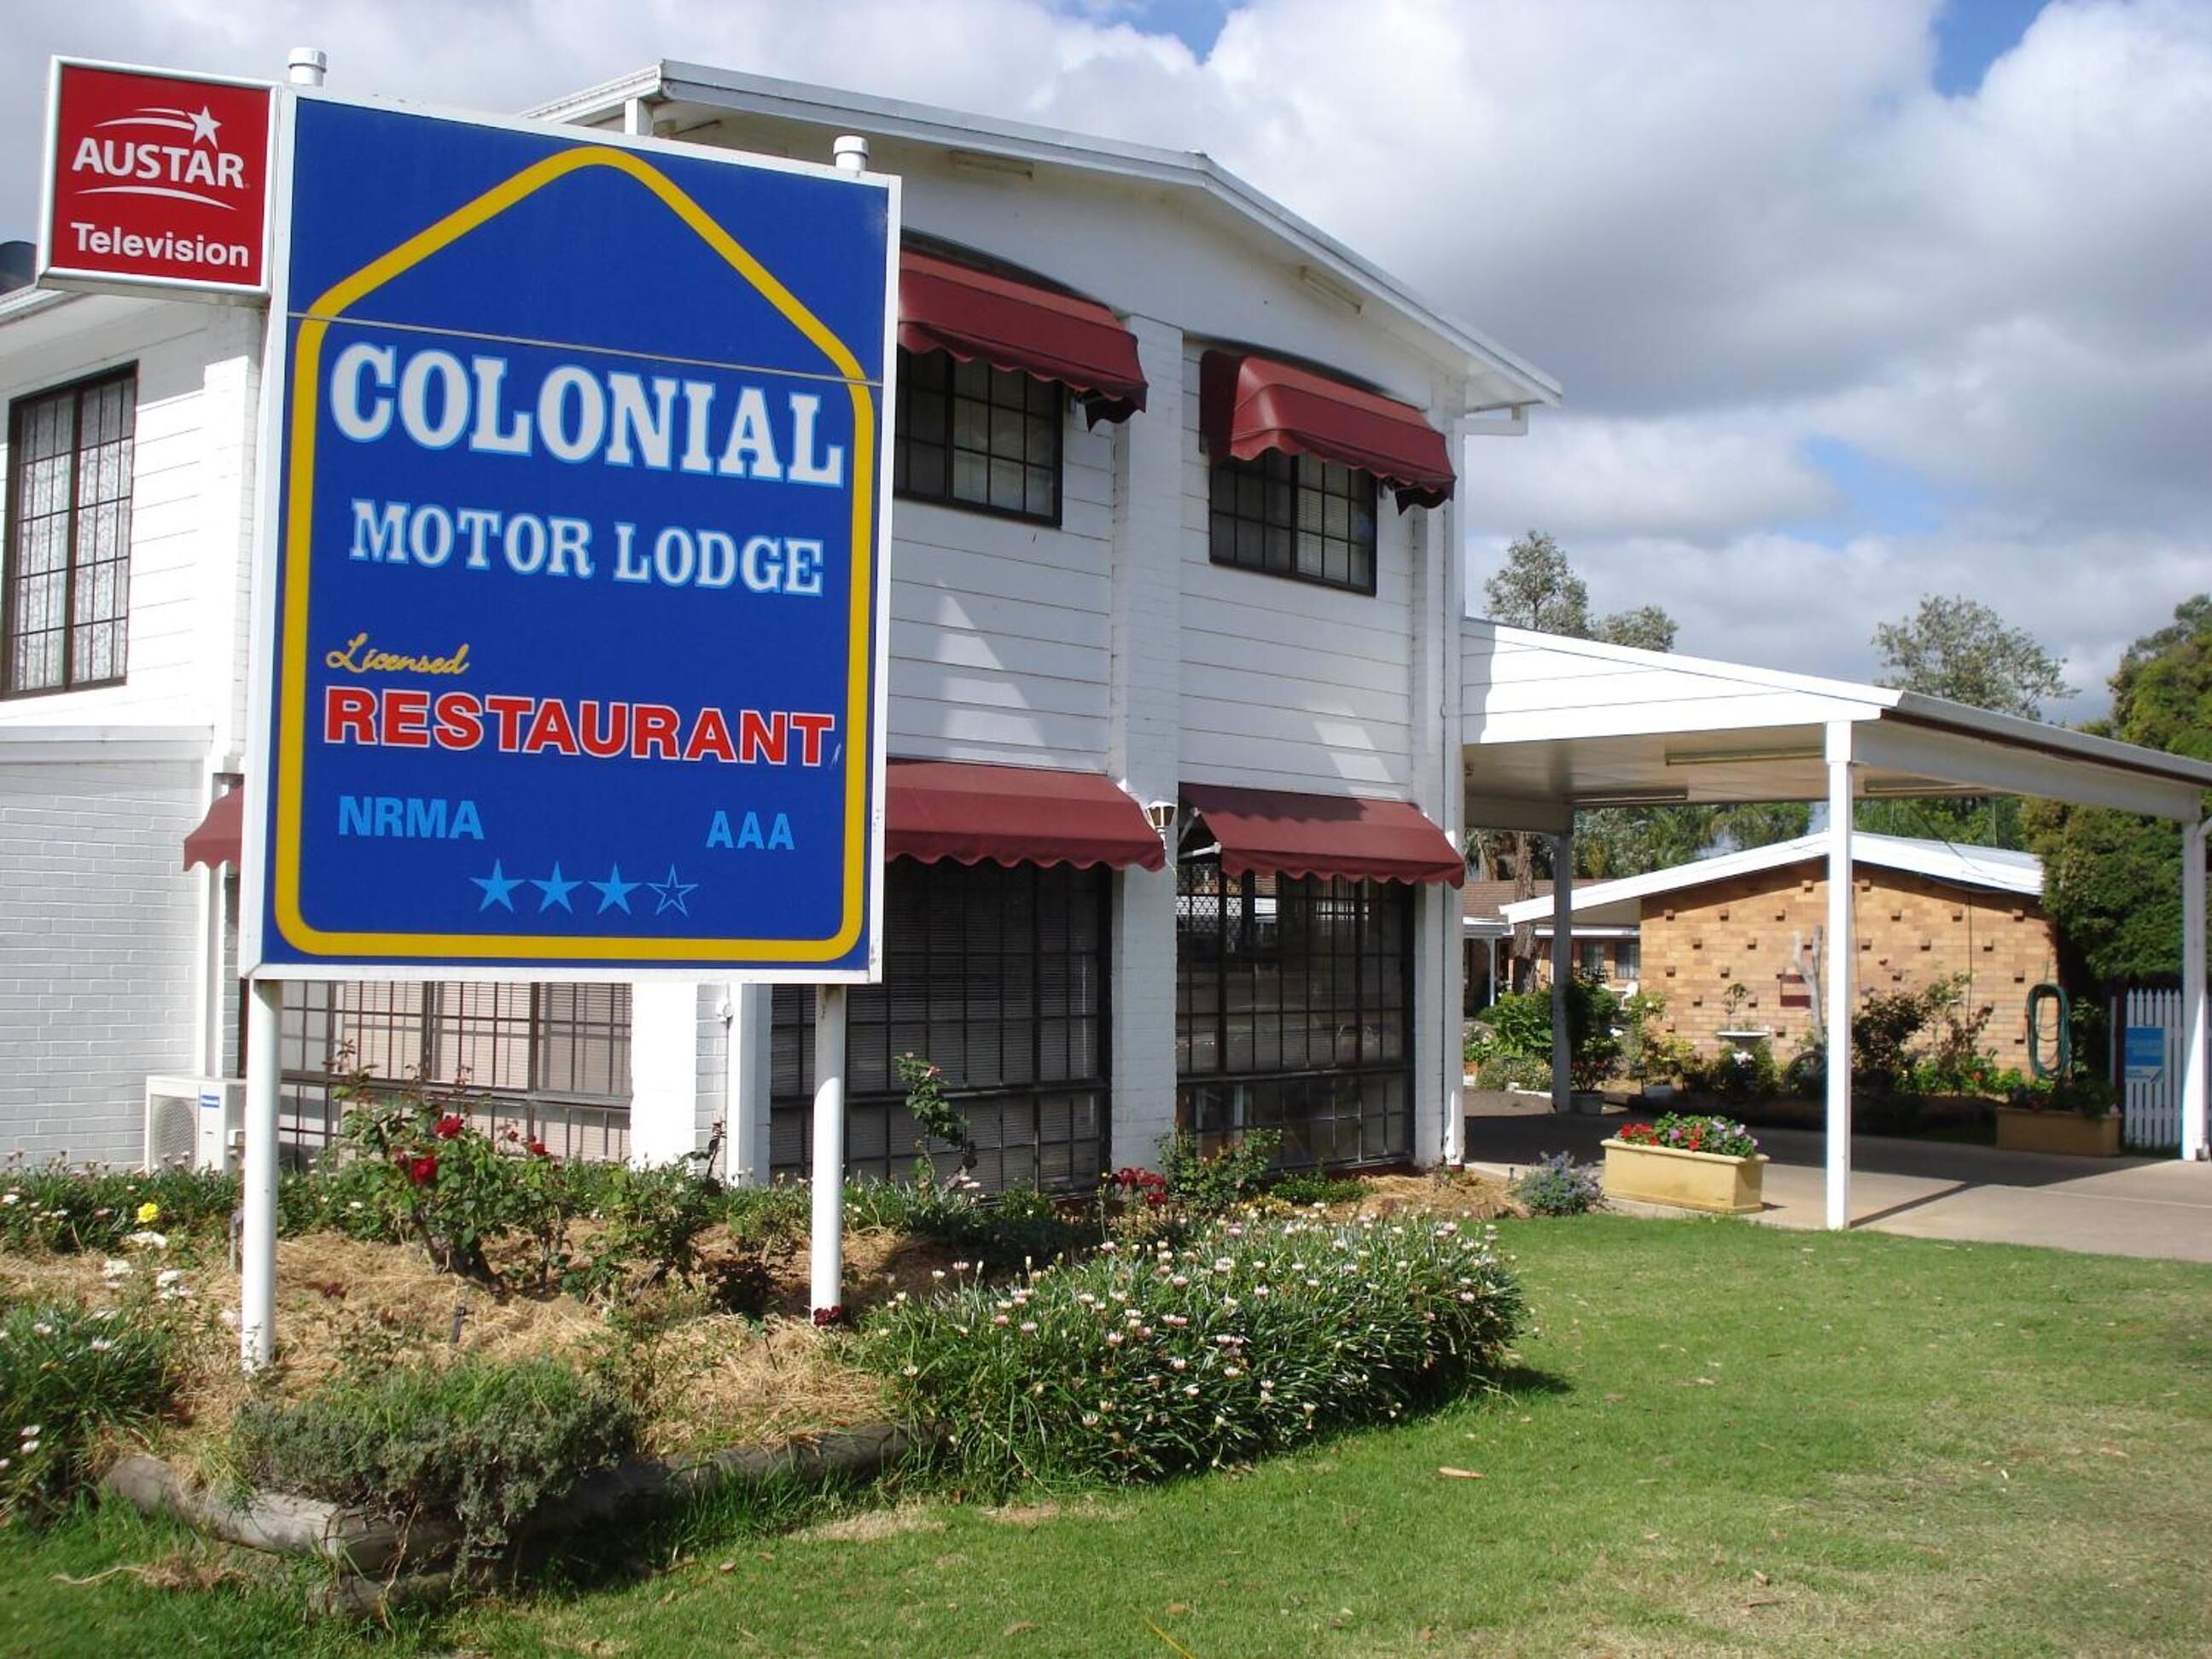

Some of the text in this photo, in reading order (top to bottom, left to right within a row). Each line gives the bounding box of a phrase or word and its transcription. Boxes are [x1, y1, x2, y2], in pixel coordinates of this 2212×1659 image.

[72, 137, 245, 189] AUSTAR
[71, 222, 249, 267] Television
[329, 342, 845, 488] COLONIAL
[349, 498, 824, 596] MOTOR LODGE
[326, 632, 470, 675] Licensed
[323, 686, 835, 767] RESTAURANT
[339, 795, 795, 851] NRMA AAA
